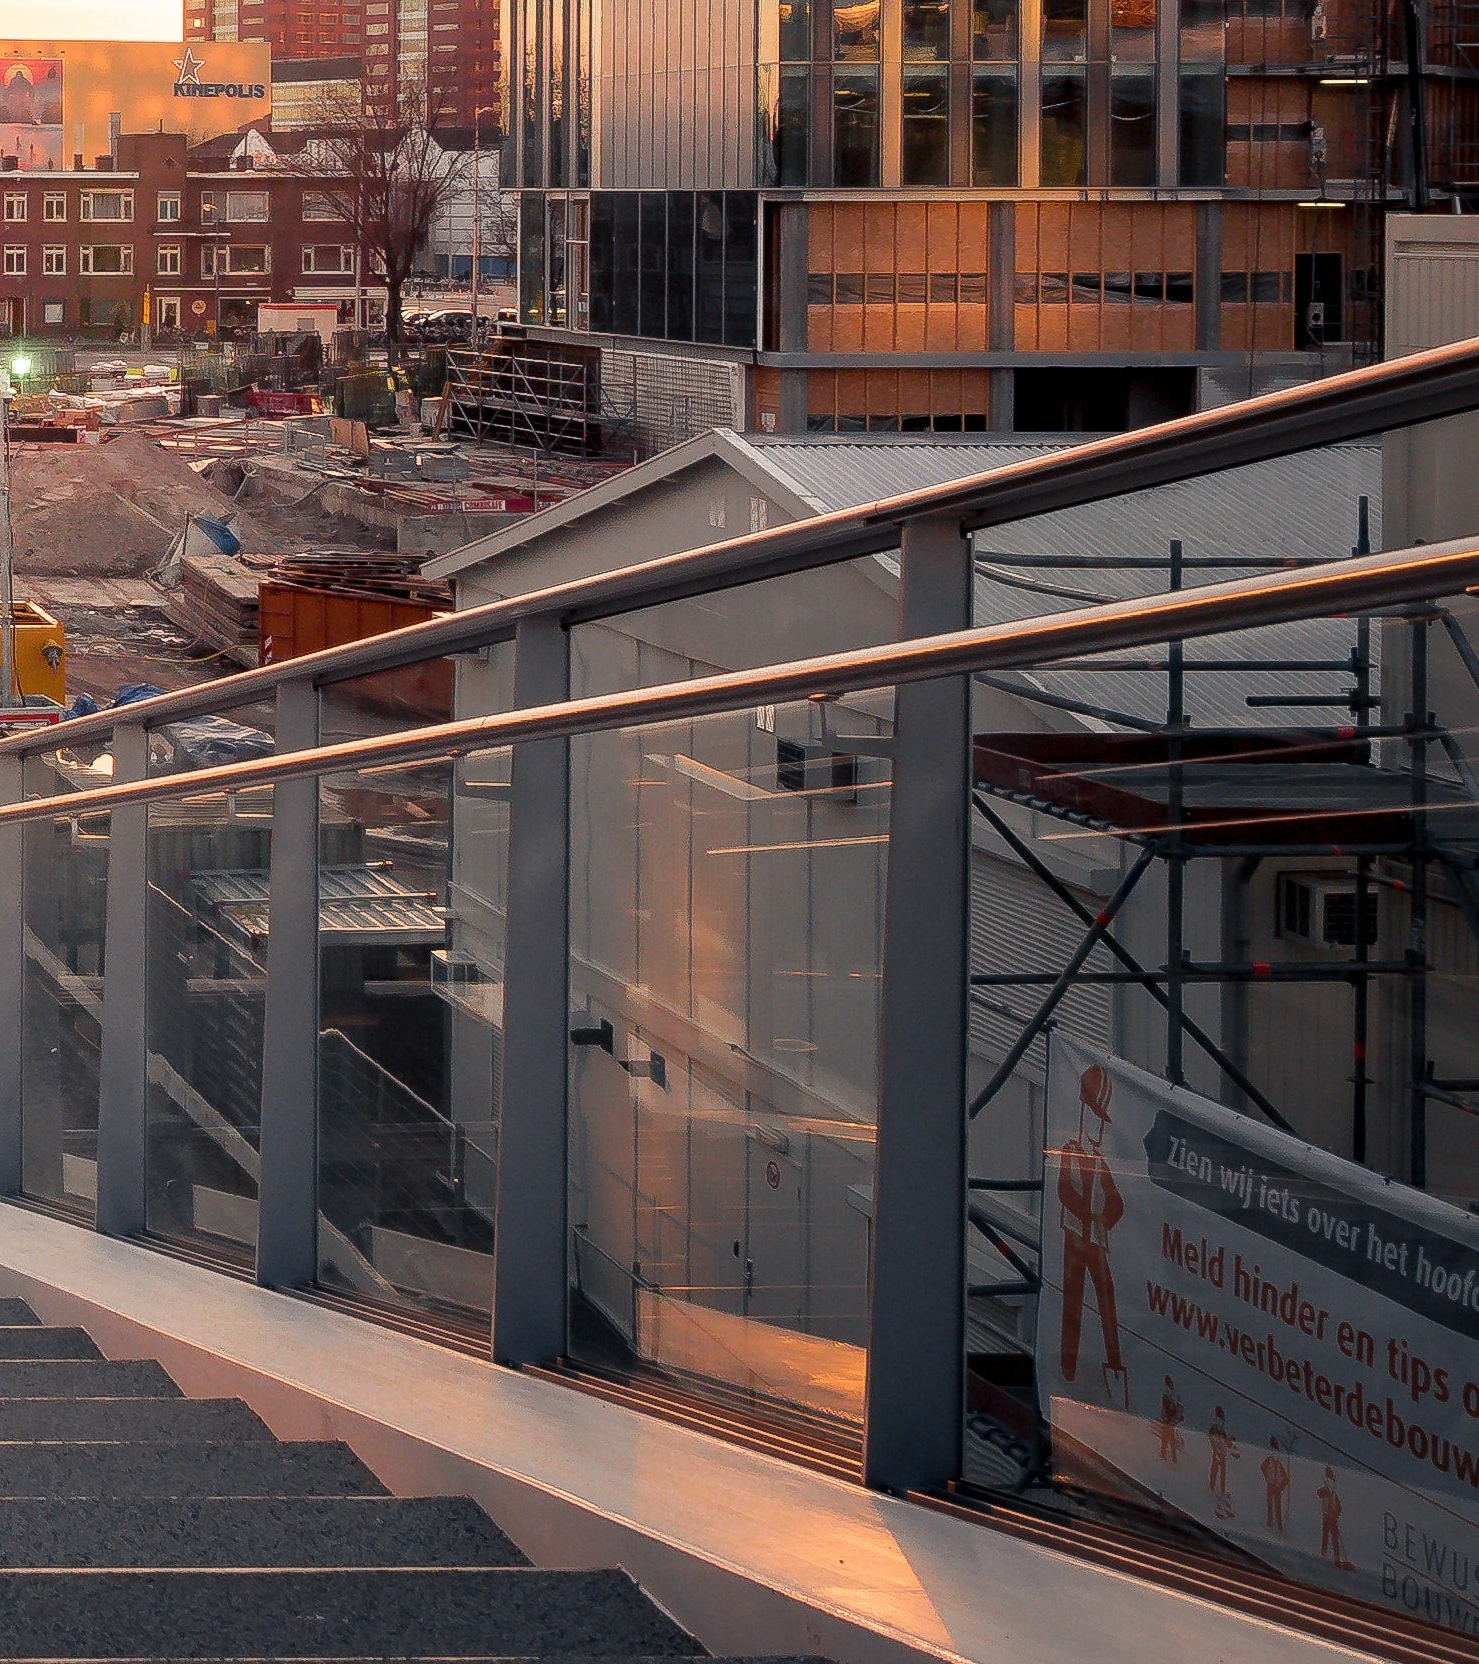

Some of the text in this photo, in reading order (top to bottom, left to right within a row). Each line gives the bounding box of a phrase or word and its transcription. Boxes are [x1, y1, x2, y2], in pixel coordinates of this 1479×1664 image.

[173, 83, 265, 98] KINEPOLIS
[1220, 1164, 1253, 1209] wij
[1259, 1175, 1300, 1224] iets
[1307, 1207, 1361, 1251] over
[1366, 1222, 1409, 1277] het
[1161, 1221, 1225, 1289] Meld
[1233, 1252, 1329, 1342] hinder
[1337, 1320, 1375, 1368] en
[1386, 1337, 1450, 1403] tips
